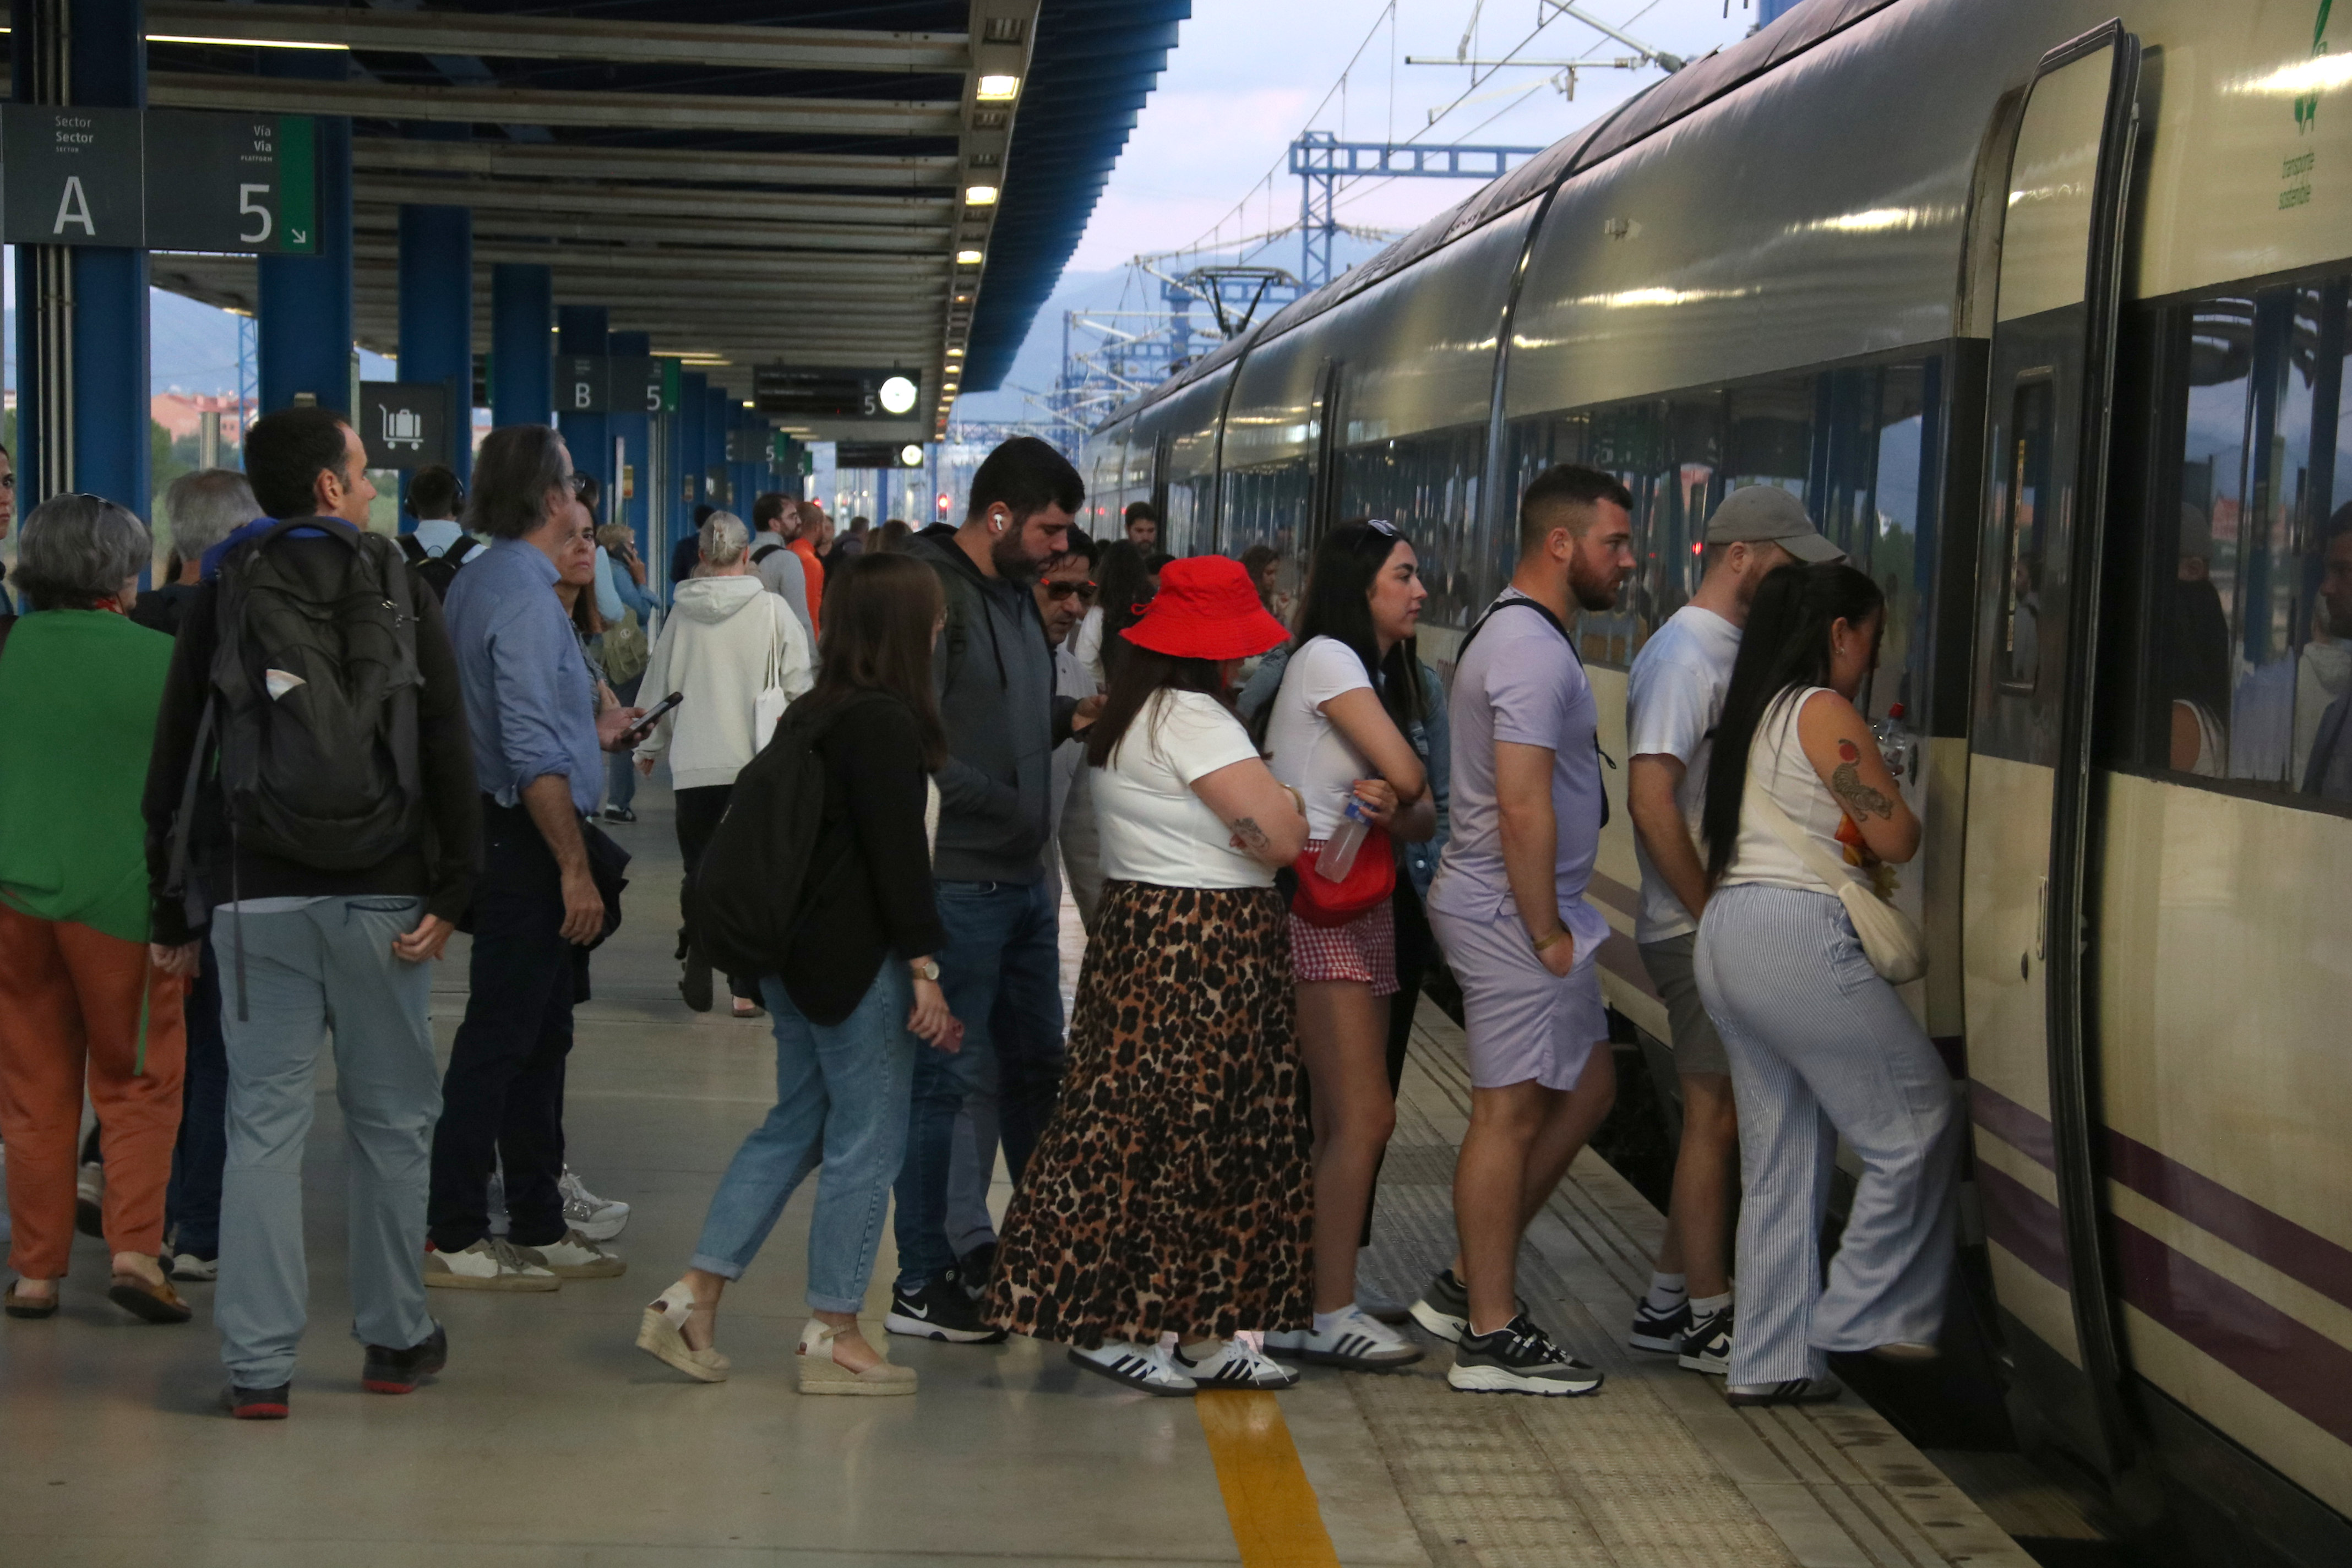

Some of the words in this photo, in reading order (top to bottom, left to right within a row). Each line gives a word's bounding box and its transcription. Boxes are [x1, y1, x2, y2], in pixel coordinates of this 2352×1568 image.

[56, 116, 91, 127] Sector
[254, 124, 271, 137] Vía
[56, 132, 94, 143] Sector
[254, 140, 272, 152] Via
[53, 176, 96, 236] A
[240, 184, 273, 243] 5
[575, 383, 591, 408] B
[647, 385, 661, 411] 5
[864, 395, 875, 415] 5
[766, 445, 775, 461] 5
